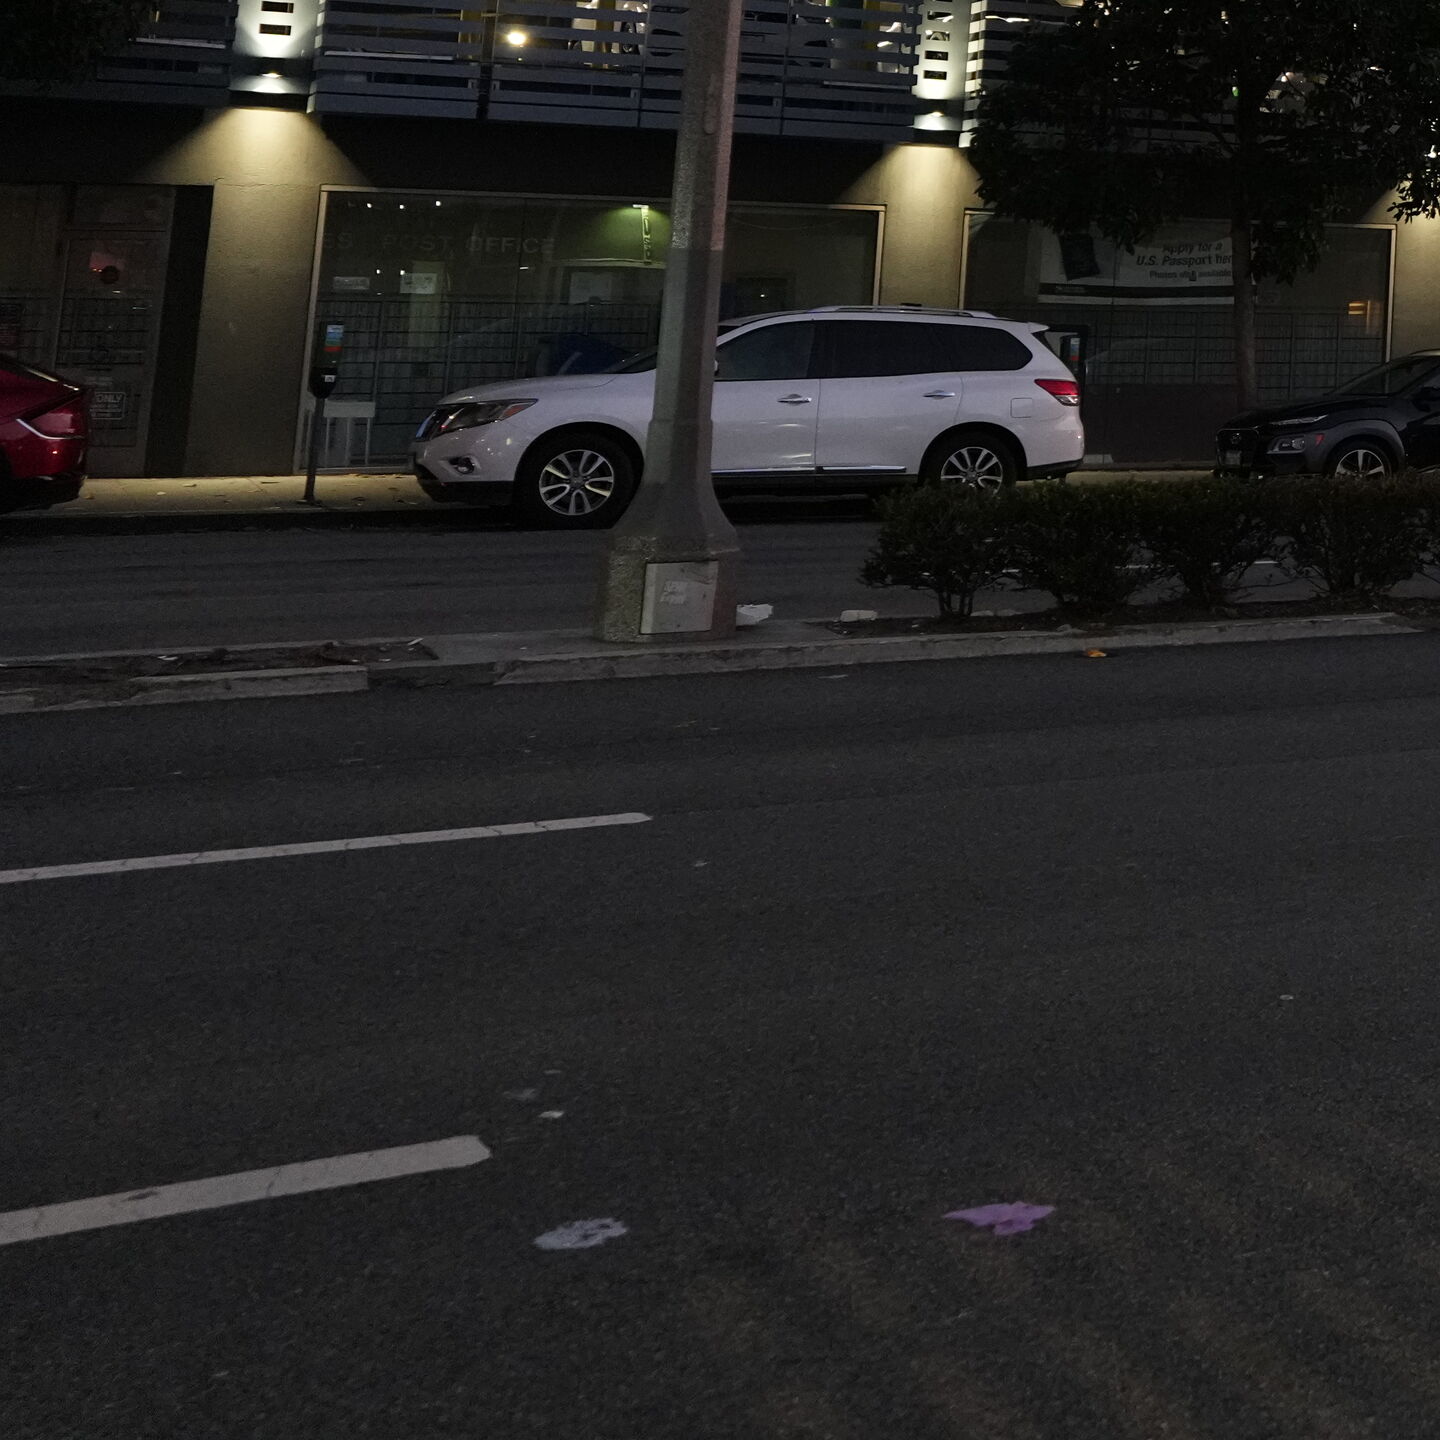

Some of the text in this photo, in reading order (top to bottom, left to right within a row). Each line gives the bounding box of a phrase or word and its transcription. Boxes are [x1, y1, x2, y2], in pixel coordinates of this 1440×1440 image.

[380, 233, 453, 253] POST
[464, 235, 556, 254] OFFICE
[1136, 254, 1232, 269] U.S. Passport her
